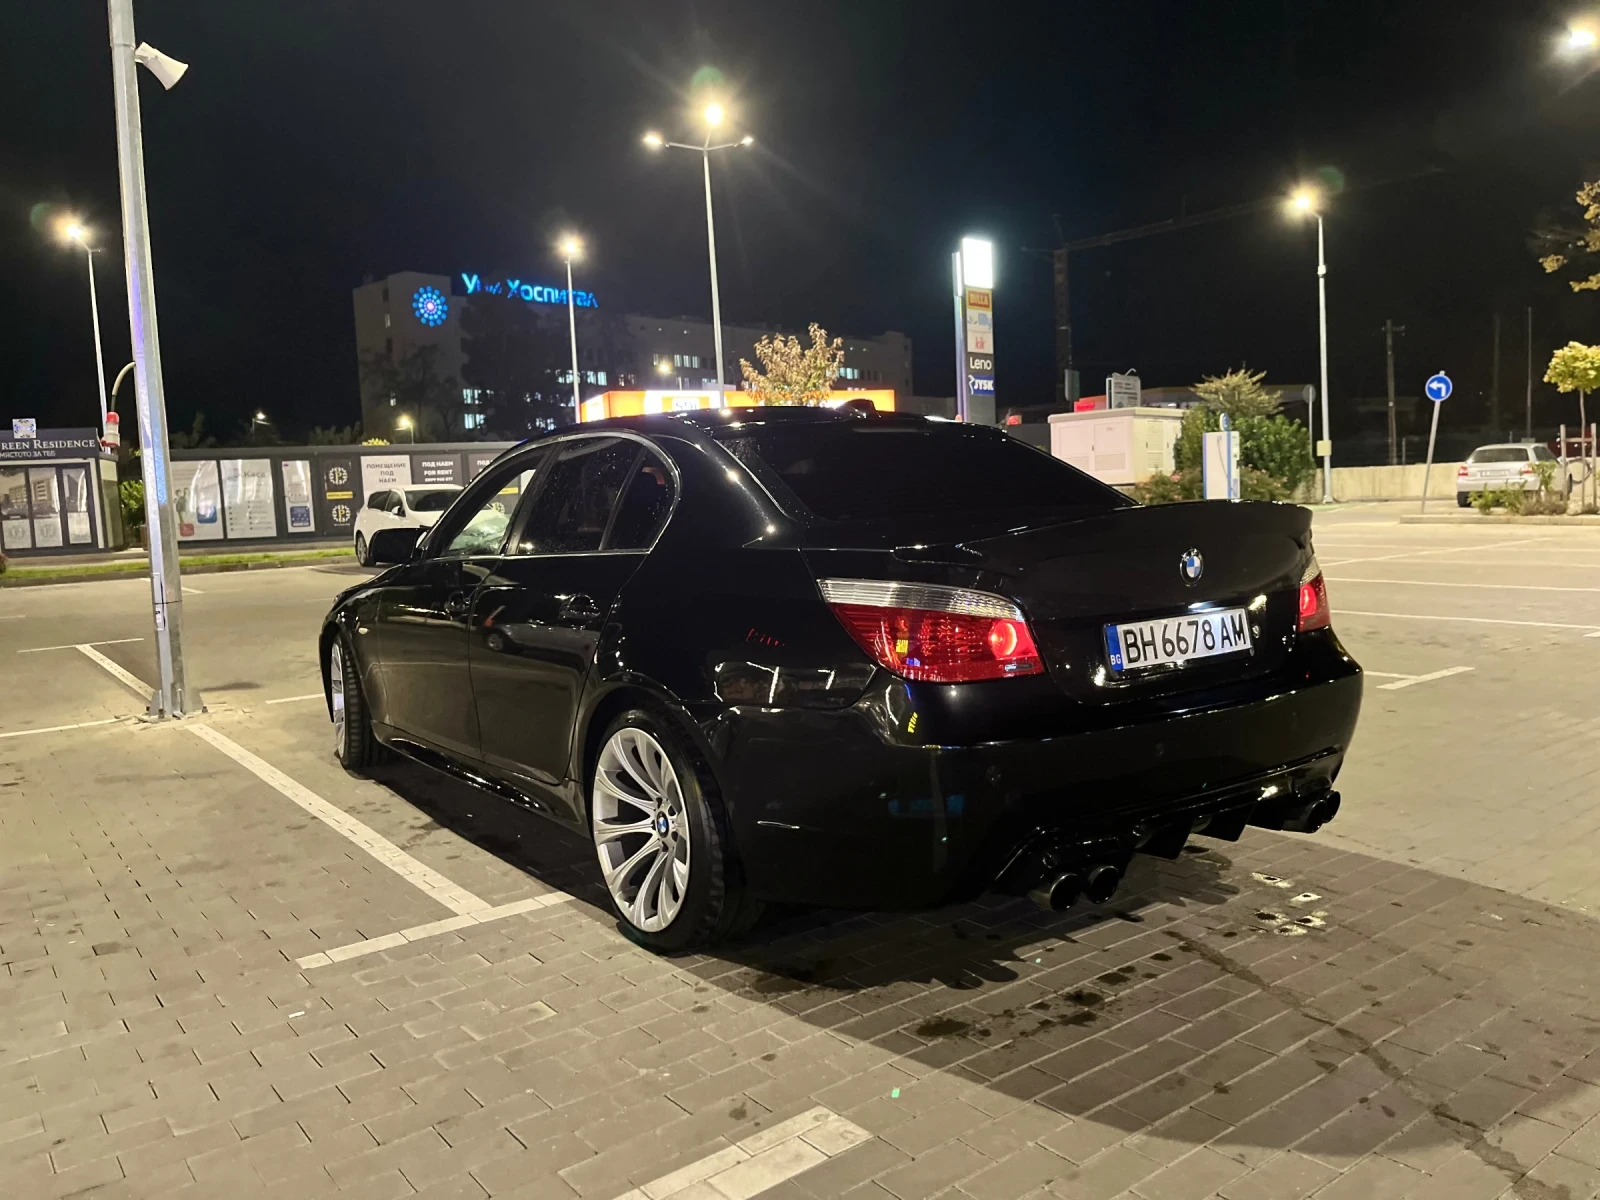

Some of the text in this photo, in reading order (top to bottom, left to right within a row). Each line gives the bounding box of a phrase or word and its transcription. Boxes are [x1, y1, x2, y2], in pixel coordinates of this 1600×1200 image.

[970, 357, 992, 370] Leno
[974, 379, 994, 391] JYSK
[0, 441, 30, 450] REEN
[1110, 654, 1122, 666] BG
